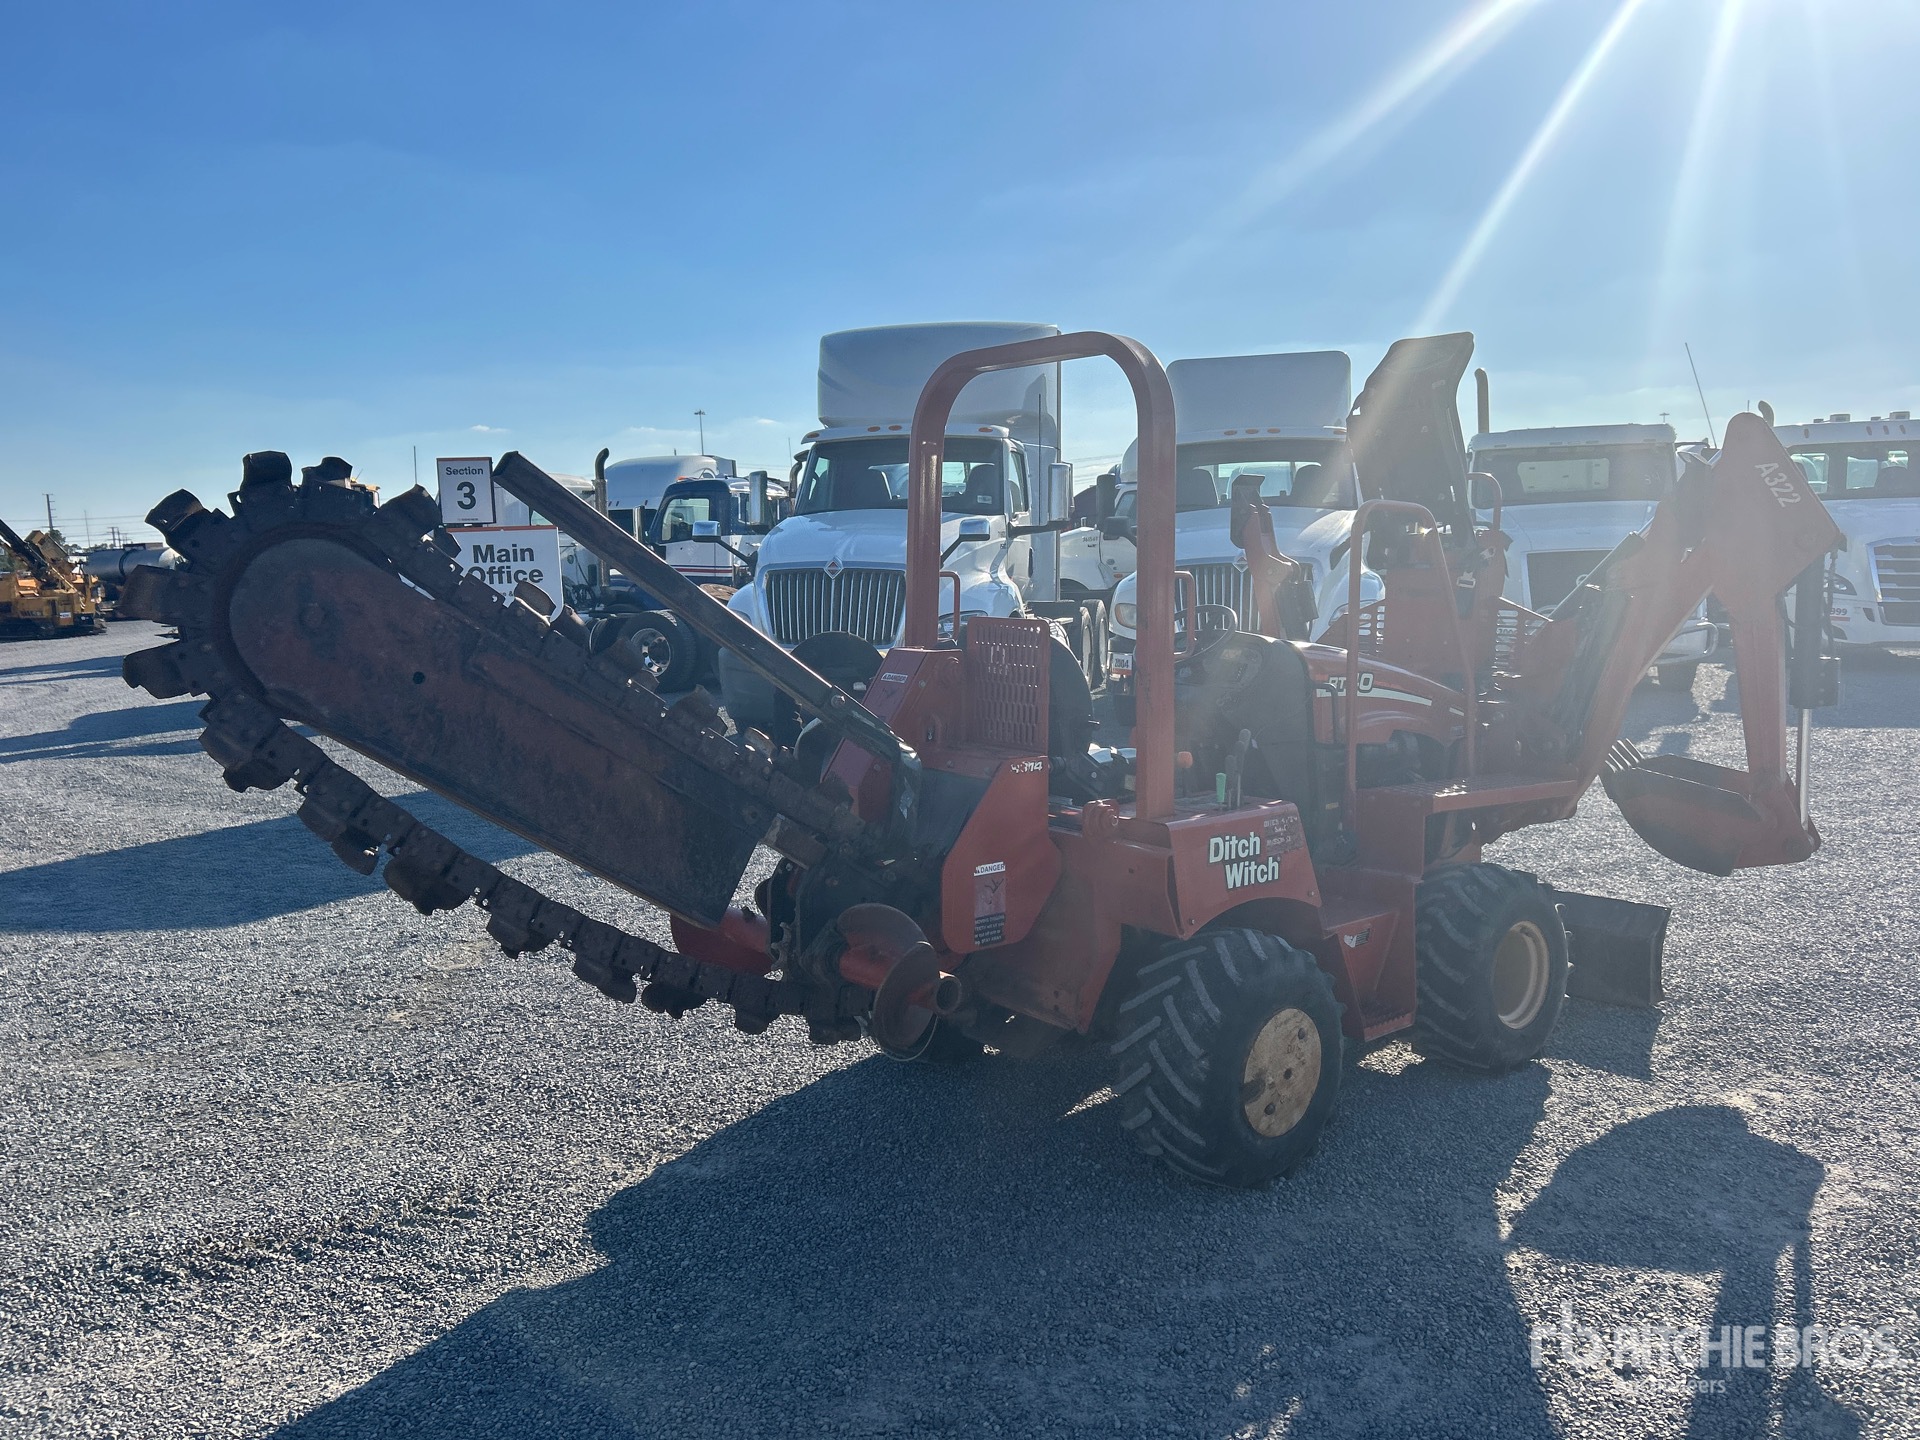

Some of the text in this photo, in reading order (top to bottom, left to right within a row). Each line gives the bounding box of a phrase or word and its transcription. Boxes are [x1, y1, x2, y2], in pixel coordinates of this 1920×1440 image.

[445, 466, 484, 476] Section
[456, 481, 477, 510] 3
[1754, 462, 1802, 508] A322
[472, 543, 535, 564] Main
[467, 565, 544, 585] Office
[1209, 831, 1261, 863] Ditch
[980, 863, 1005, 873] DANGER
[1225, 856, 1279, 889] Witch
